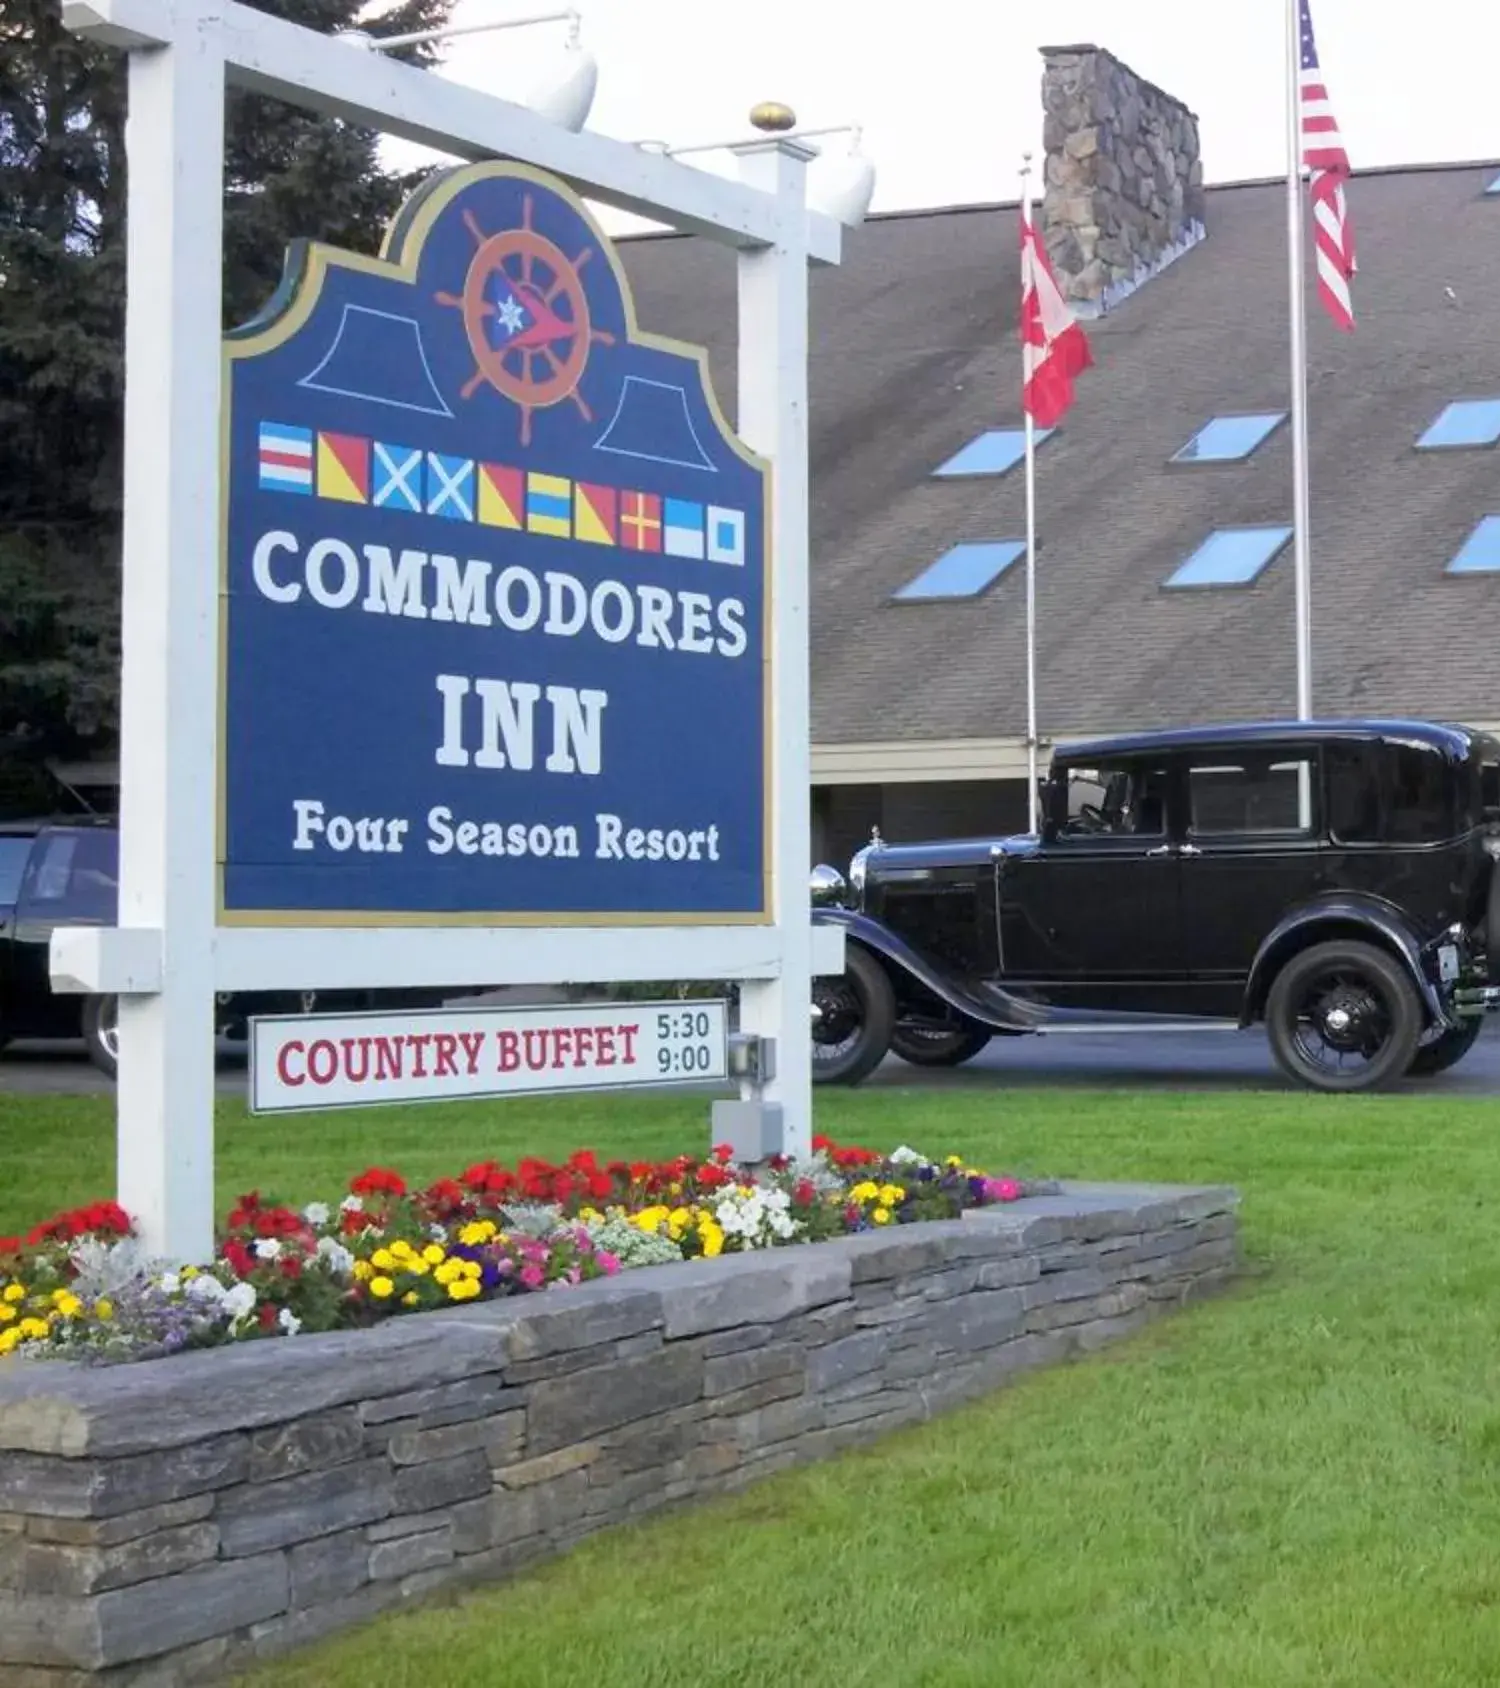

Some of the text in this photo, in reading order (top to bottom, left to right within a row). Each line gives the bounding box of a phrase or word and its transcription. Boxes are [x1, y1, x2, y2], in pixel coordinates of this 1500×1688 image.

[252, 530, 748, 658] COMMODORES
[436, 674, 609, 774] INN
[293, 799, 720, 861] Four Season Resort
[277, 1024, 639, 1086] COUNTRY BUFFET
[657, 1013, 709, 1039] 5:30
[657, 1046, 710, 1073] 9:00
